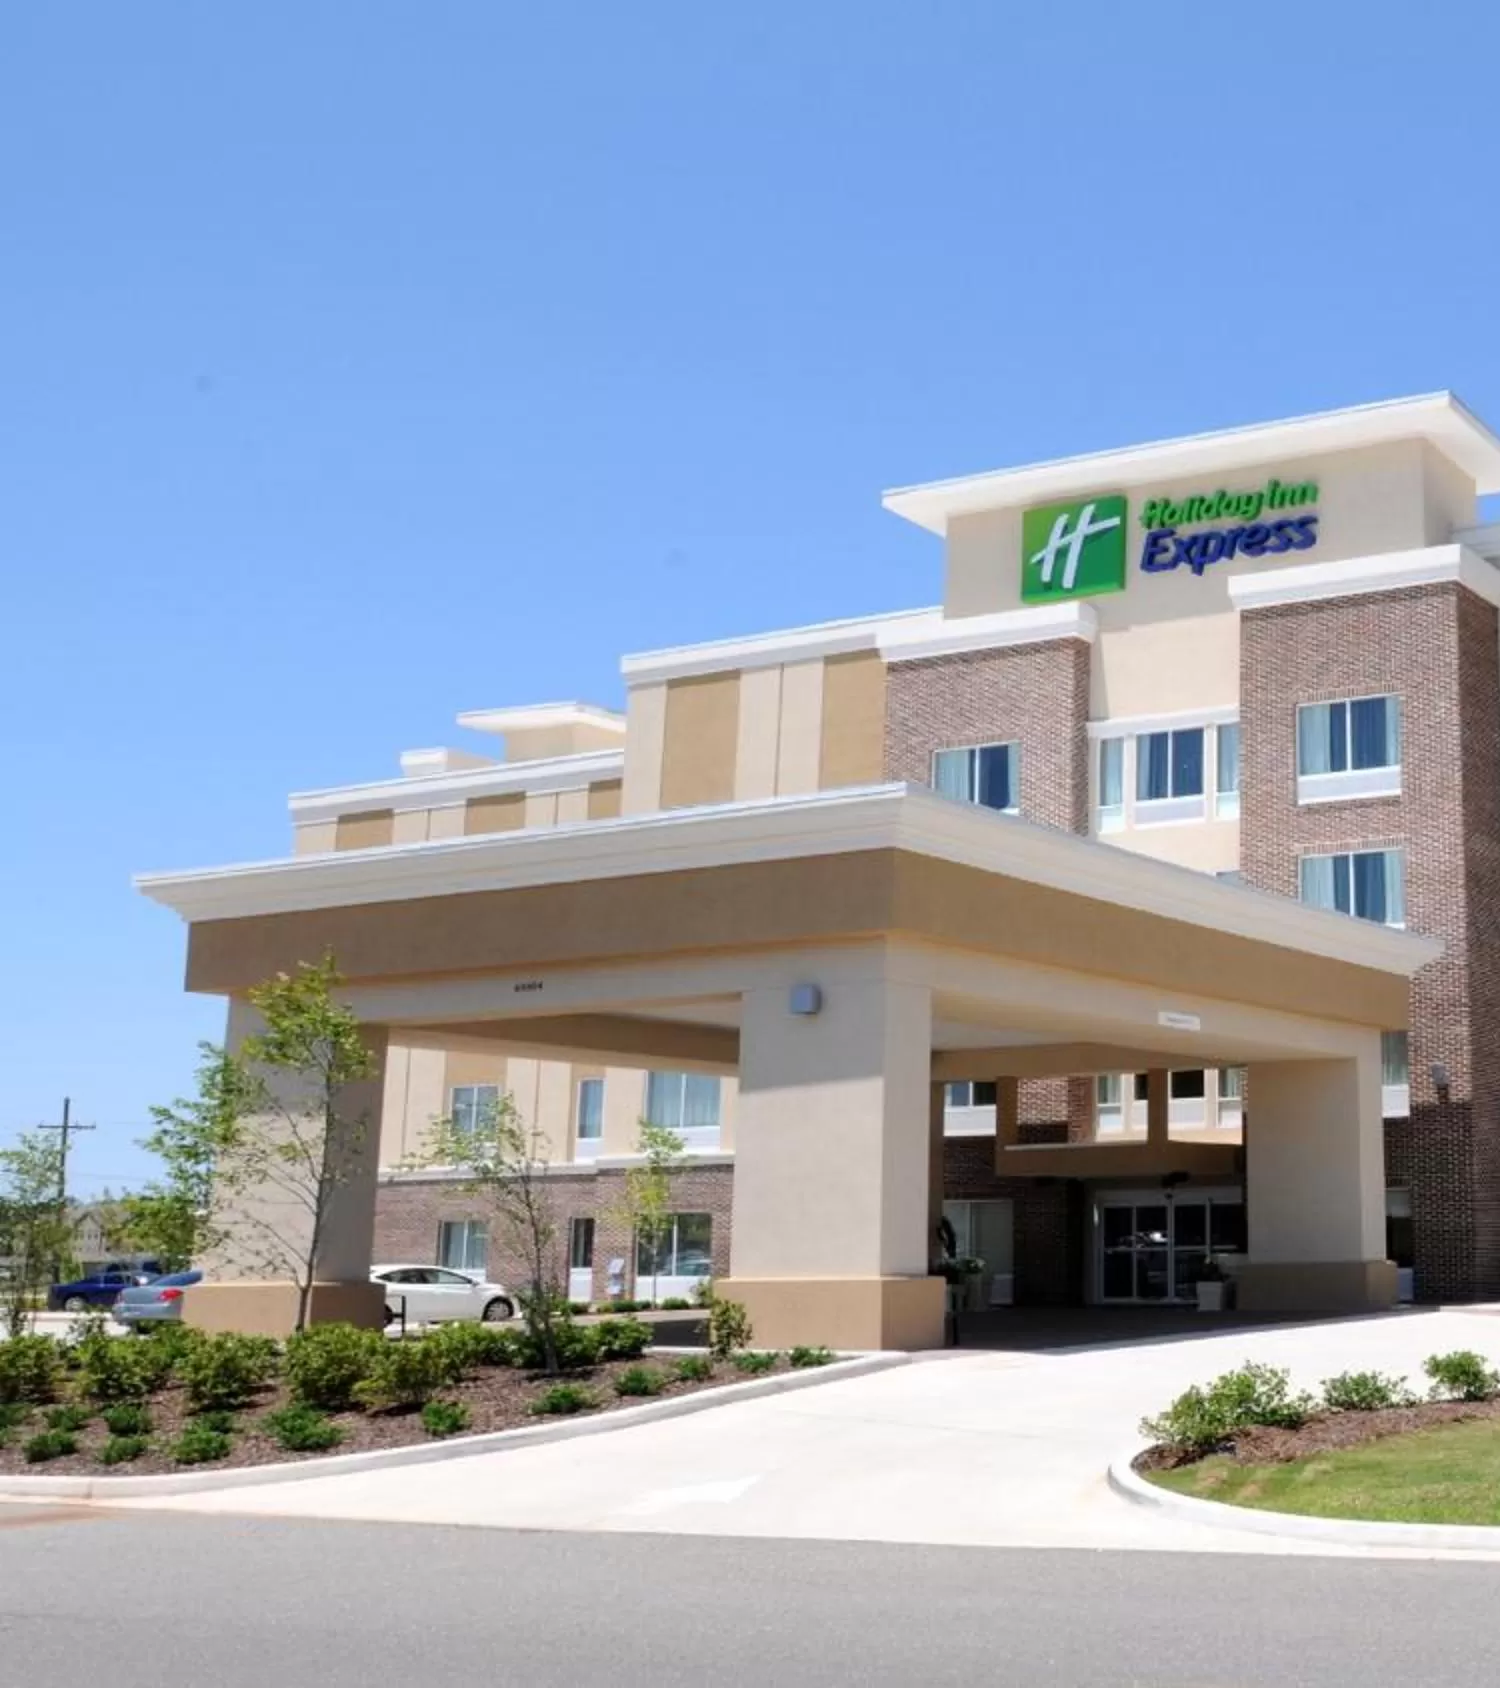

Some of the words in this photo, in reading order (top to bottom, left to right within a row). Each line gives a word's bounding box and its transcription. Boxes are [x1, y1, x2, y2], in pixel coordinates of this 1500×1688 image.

[1140, 489, 1264, 529] Holiday
[1265, 479, 1319, 509] Inn
[1030, 503, 1122, 589] H
[1139, 515, 1318, 576] Express
